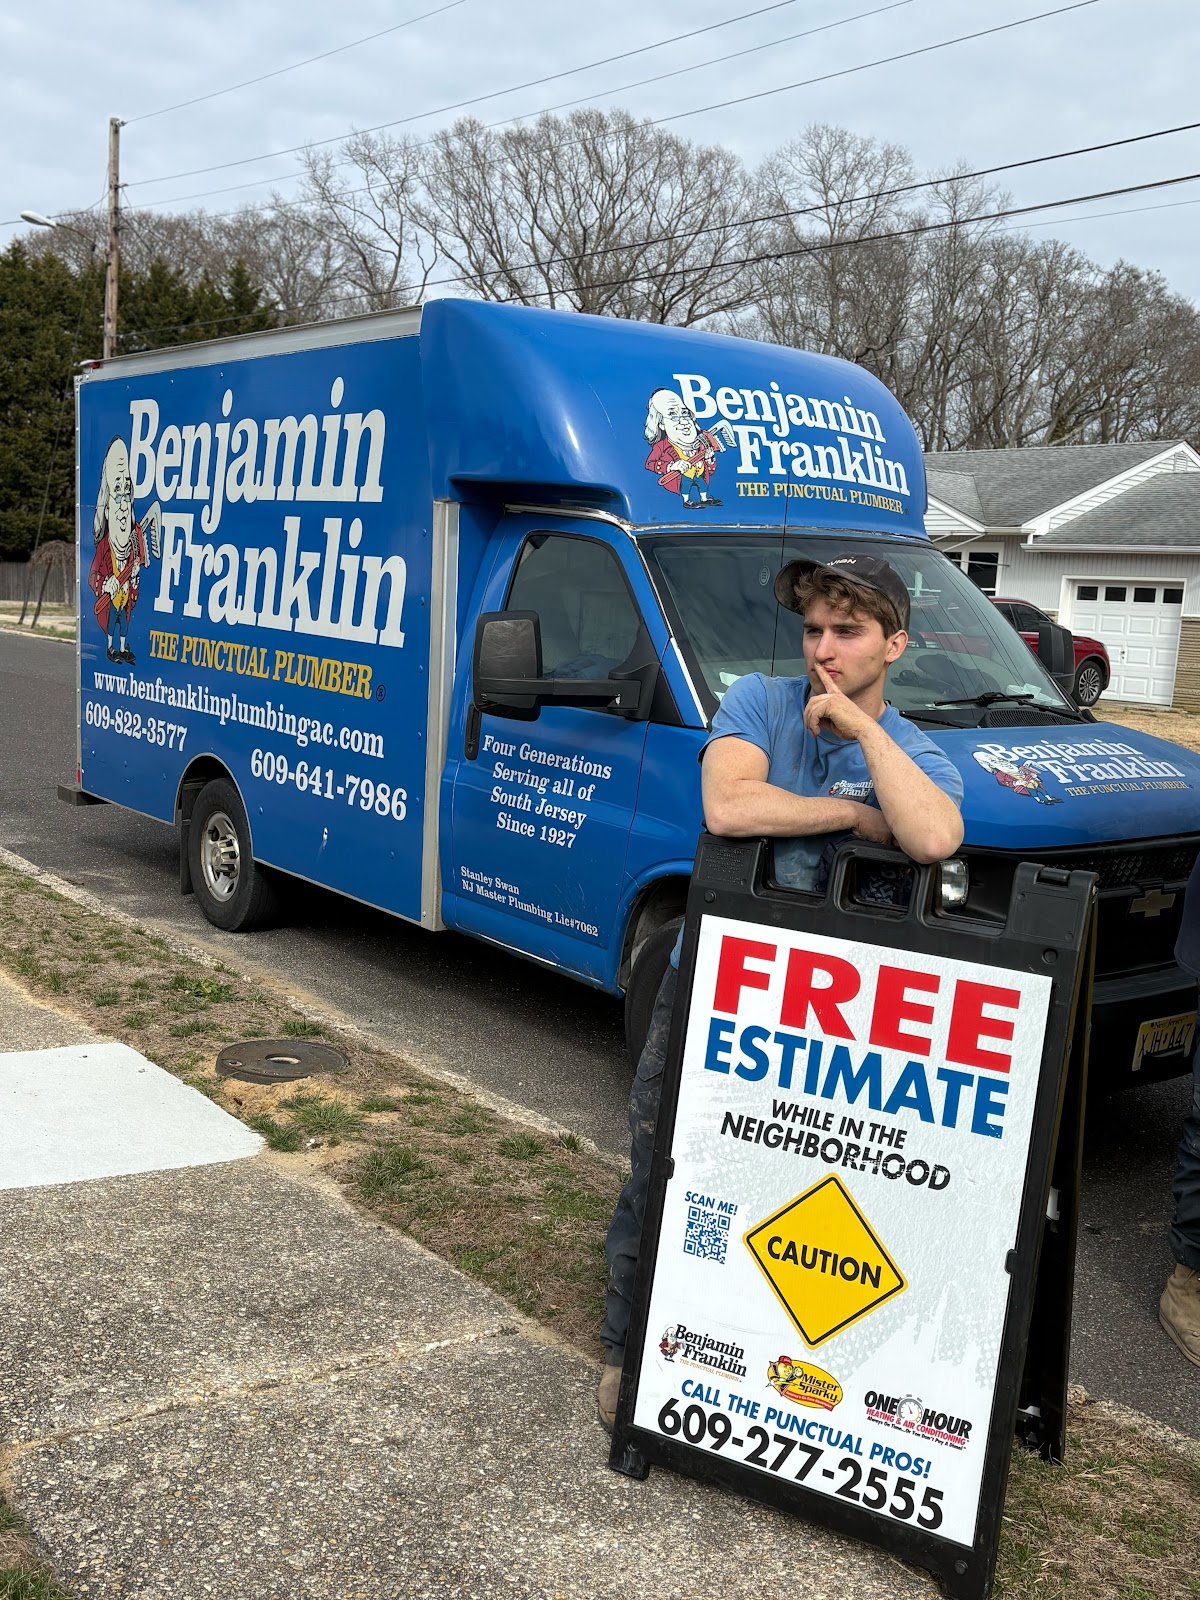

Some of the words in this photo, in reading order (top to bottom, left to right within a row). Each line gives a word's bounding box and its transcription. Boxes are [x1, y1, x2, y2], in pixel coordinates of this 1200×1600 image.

[673, 374, 886, 443] Benjamin
[129, 376, 386, 534] Benjamin
[733, 424, 910, 496] Franklin
[736, 482, 770, 497] THE
[773, 483, 847, 502] PUNCTUAL
[850, 490, 903, 514] PLUMBER
[154, 512, 408, 648] Franklin
[150, 629, 179, 659] THE
[181, 633, 269, 676] PUNCTUAL
[273, 649, 373, 700] PLUMBER
[85, 701, 188, 752] 609-822-3577
[93, 671, 384, 759] www.benfranklinplumbingac.com
[482, 735, 516, 758] Four
[519, 742, 612, 779] Generations
[976, 739, 1143, 763] Benjamin
[1040, 756, 1186, 784] Franklin
[251, 748, 408, 821] 609-641-7986
[492, 762, 550, 794] Serving
[552, 778, 574, 796] all
[577, 784, 596, 801] of
[1064, 785, 1088, 797] THE
[1089, 783, 1143, 794] PUNCTUAL
[1143, 781, 1190, 791] PLUMBER
[490, 785, 532, 812] South
[535, 798, 587, 830] Jersey
[496, 811, 536, 837] Since
[540, 824, 576, 849] 1927
[460, 865, 494, 888] Stanley
[494, 876, 520, 895] Swan
[462, 879, 473, 892] NJ
[476, 885, 507, 904] Master
[508, 895, 553, 923] Plumbing
[554, 911, 598, 937] Lic#7062
[713, 935, 1021, 1074] FREE
[704, 1017, 1010, 1139] ESTIMATE
[771, 1098, 835, 1132] WHILE
[838, 1117, 865, 1139] IN
[869, 1123, 907, 1150] THE
[720, 1111, 951, 1190] NEIGHBORHOOD
[684, 1190, 715, 1208] SCAN
[717, 1201, 738, 1216] ME!
[767, 1235, 882, 1289] CAUTION
[676, 1324, 744, 1359] Benjamin
[682, 1343, 747, 1377] Franklin
[798, 1382, 838, 1402] Sparky
[802, 1373, 839, 1391] Mister
[681, 1379, 723, 1409] CALL
[728, 1393, 760, 1421] THE
[764, 1406, 863, 1456] PUNCTUAL
[869, 1443, 931, 1479] PROS!
[864, 1390, 900, 1415] ONE
[921, 1408, 972, 1439] HOUR
[866, 1408, 894, 1423] HEATING
[895, 1417, 902, 1425] &
[903, 1420, 915, 1429] AIR
[916, 1424, 966, 1446] CONDITIONING
[657, 1398, 944, 1530] 609-277-2555
